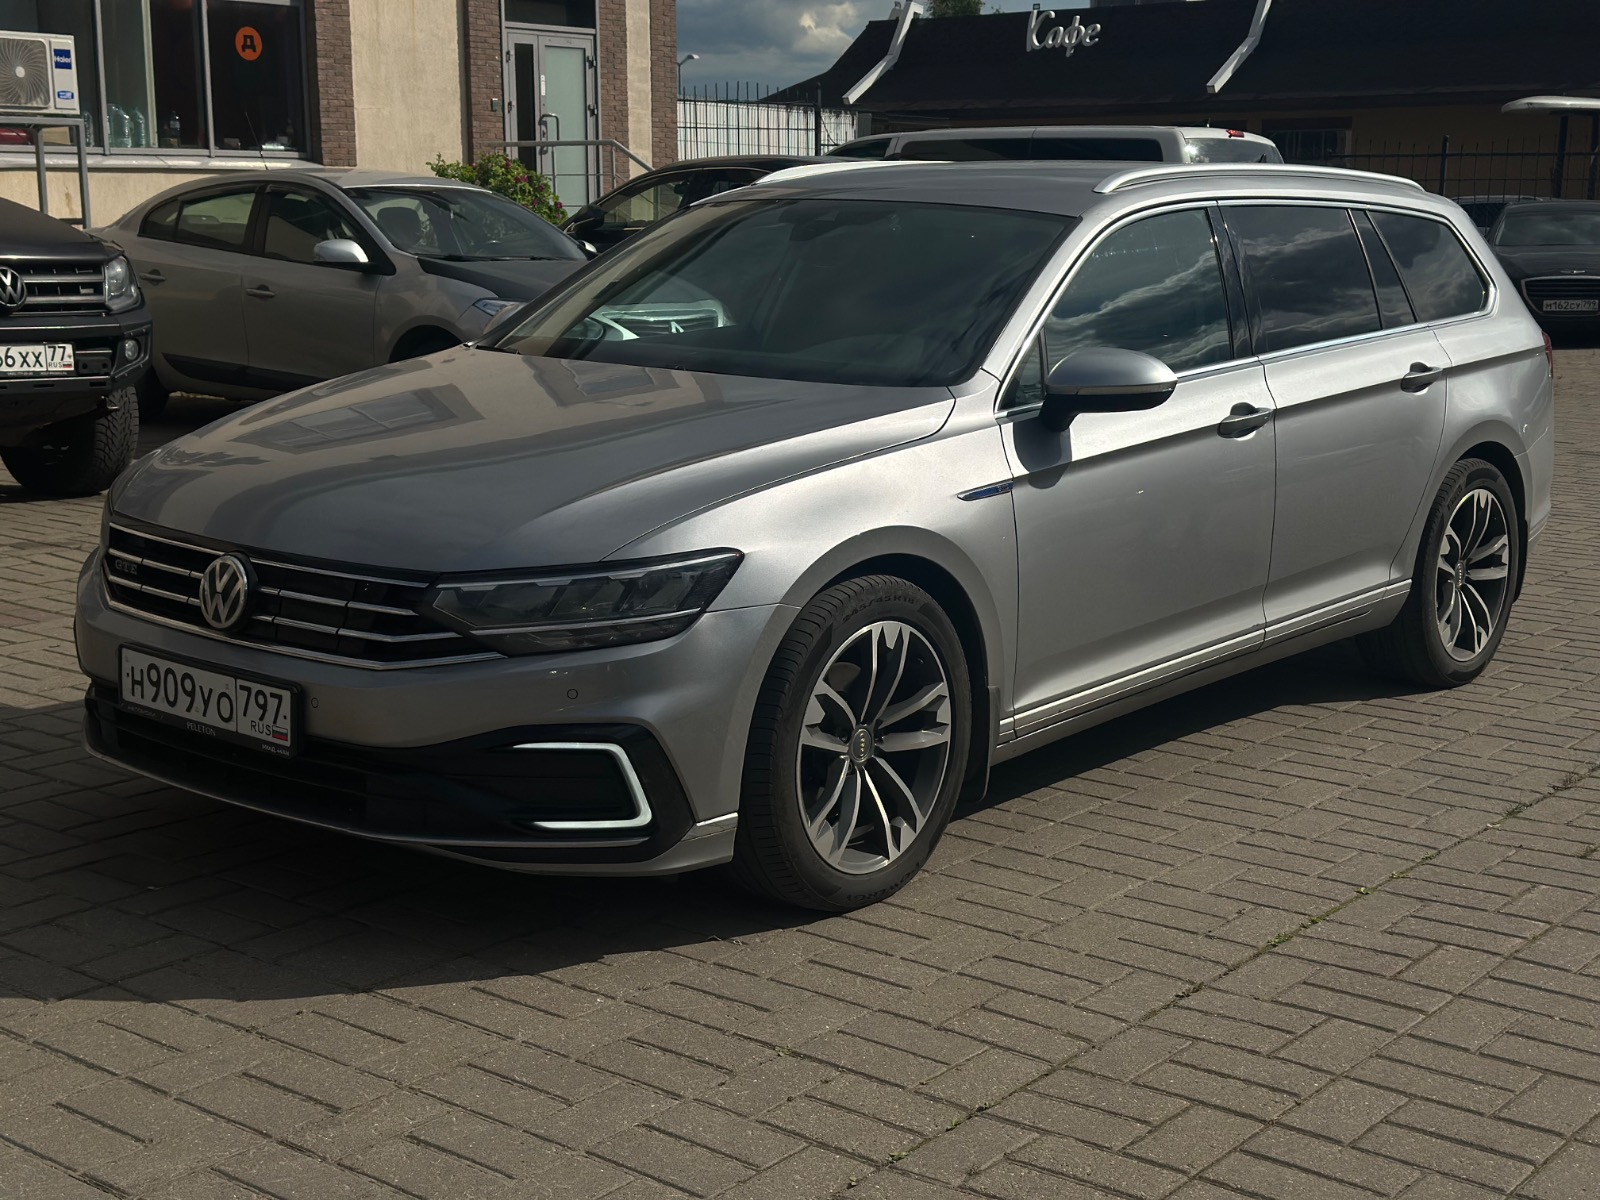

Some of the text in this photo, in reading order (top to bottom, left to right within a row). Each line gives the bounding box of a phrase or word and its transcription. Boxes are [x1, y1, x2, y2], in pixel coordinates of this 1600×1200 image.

[1026, 9, 1101, 57] Кафе
[242, 34, 257, 53] Д
[54, 55, 72, 63] Haier
[48, 345, 66, 361] 77
[114, 559, 138, 575] GTE
[239, 685, 283, 724] 797
[186, 721, 216, 736] PELETON
[250, 720, 271, 736] RUS
